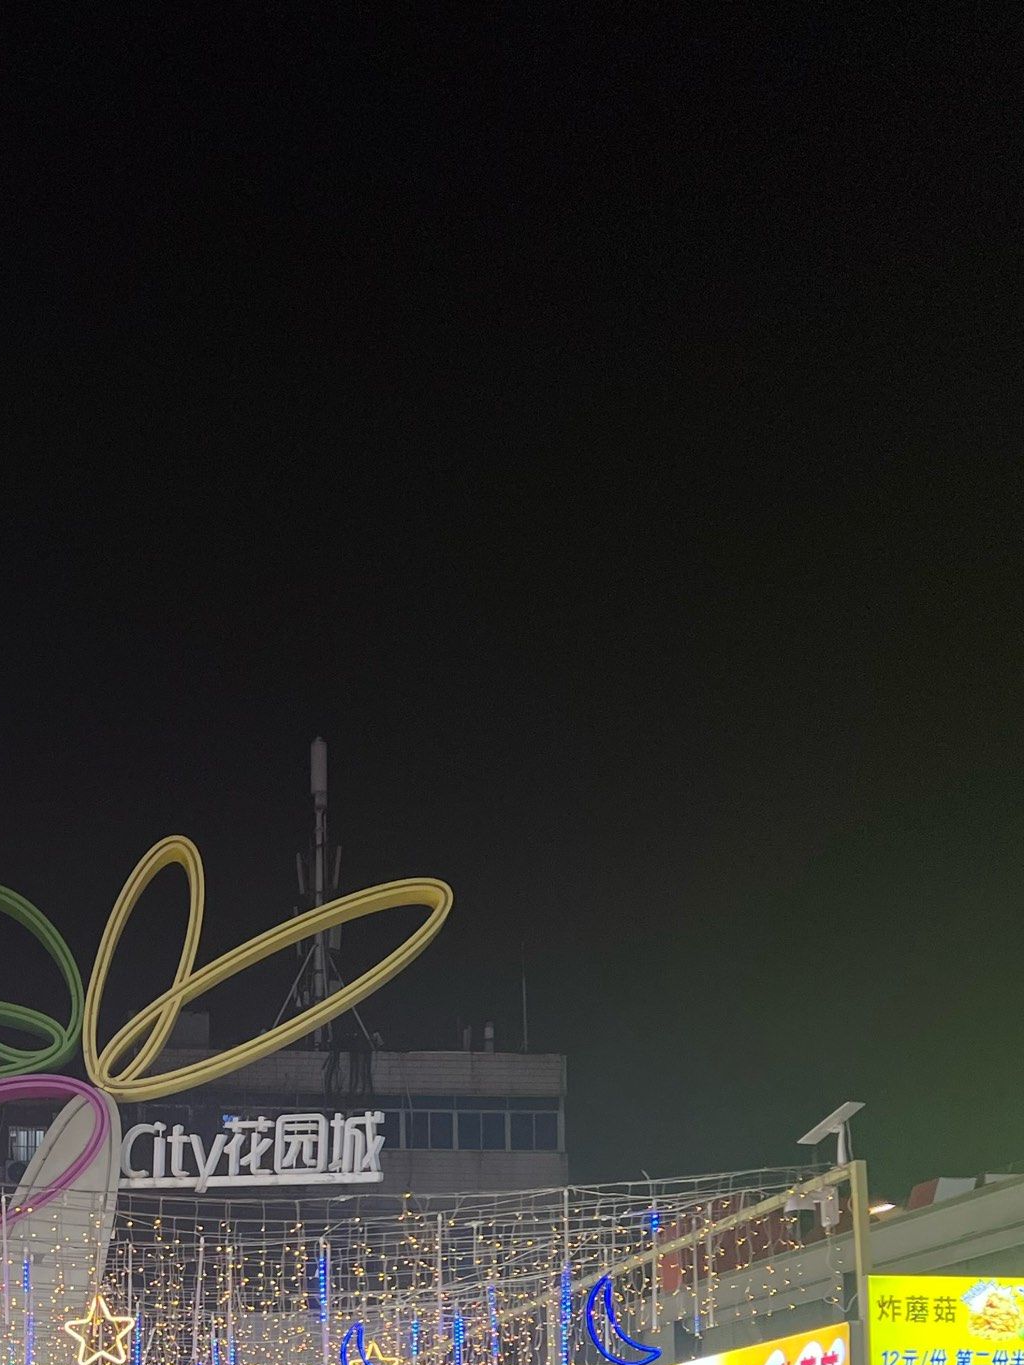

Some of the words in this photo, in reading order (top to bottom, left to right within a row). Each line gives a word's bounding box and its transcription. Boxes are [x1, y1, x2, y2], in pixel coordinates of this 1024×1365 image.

[121, 1110, 386, 1193] City花园城
[877, 1294, 957, 1323] 炸蘑菇
